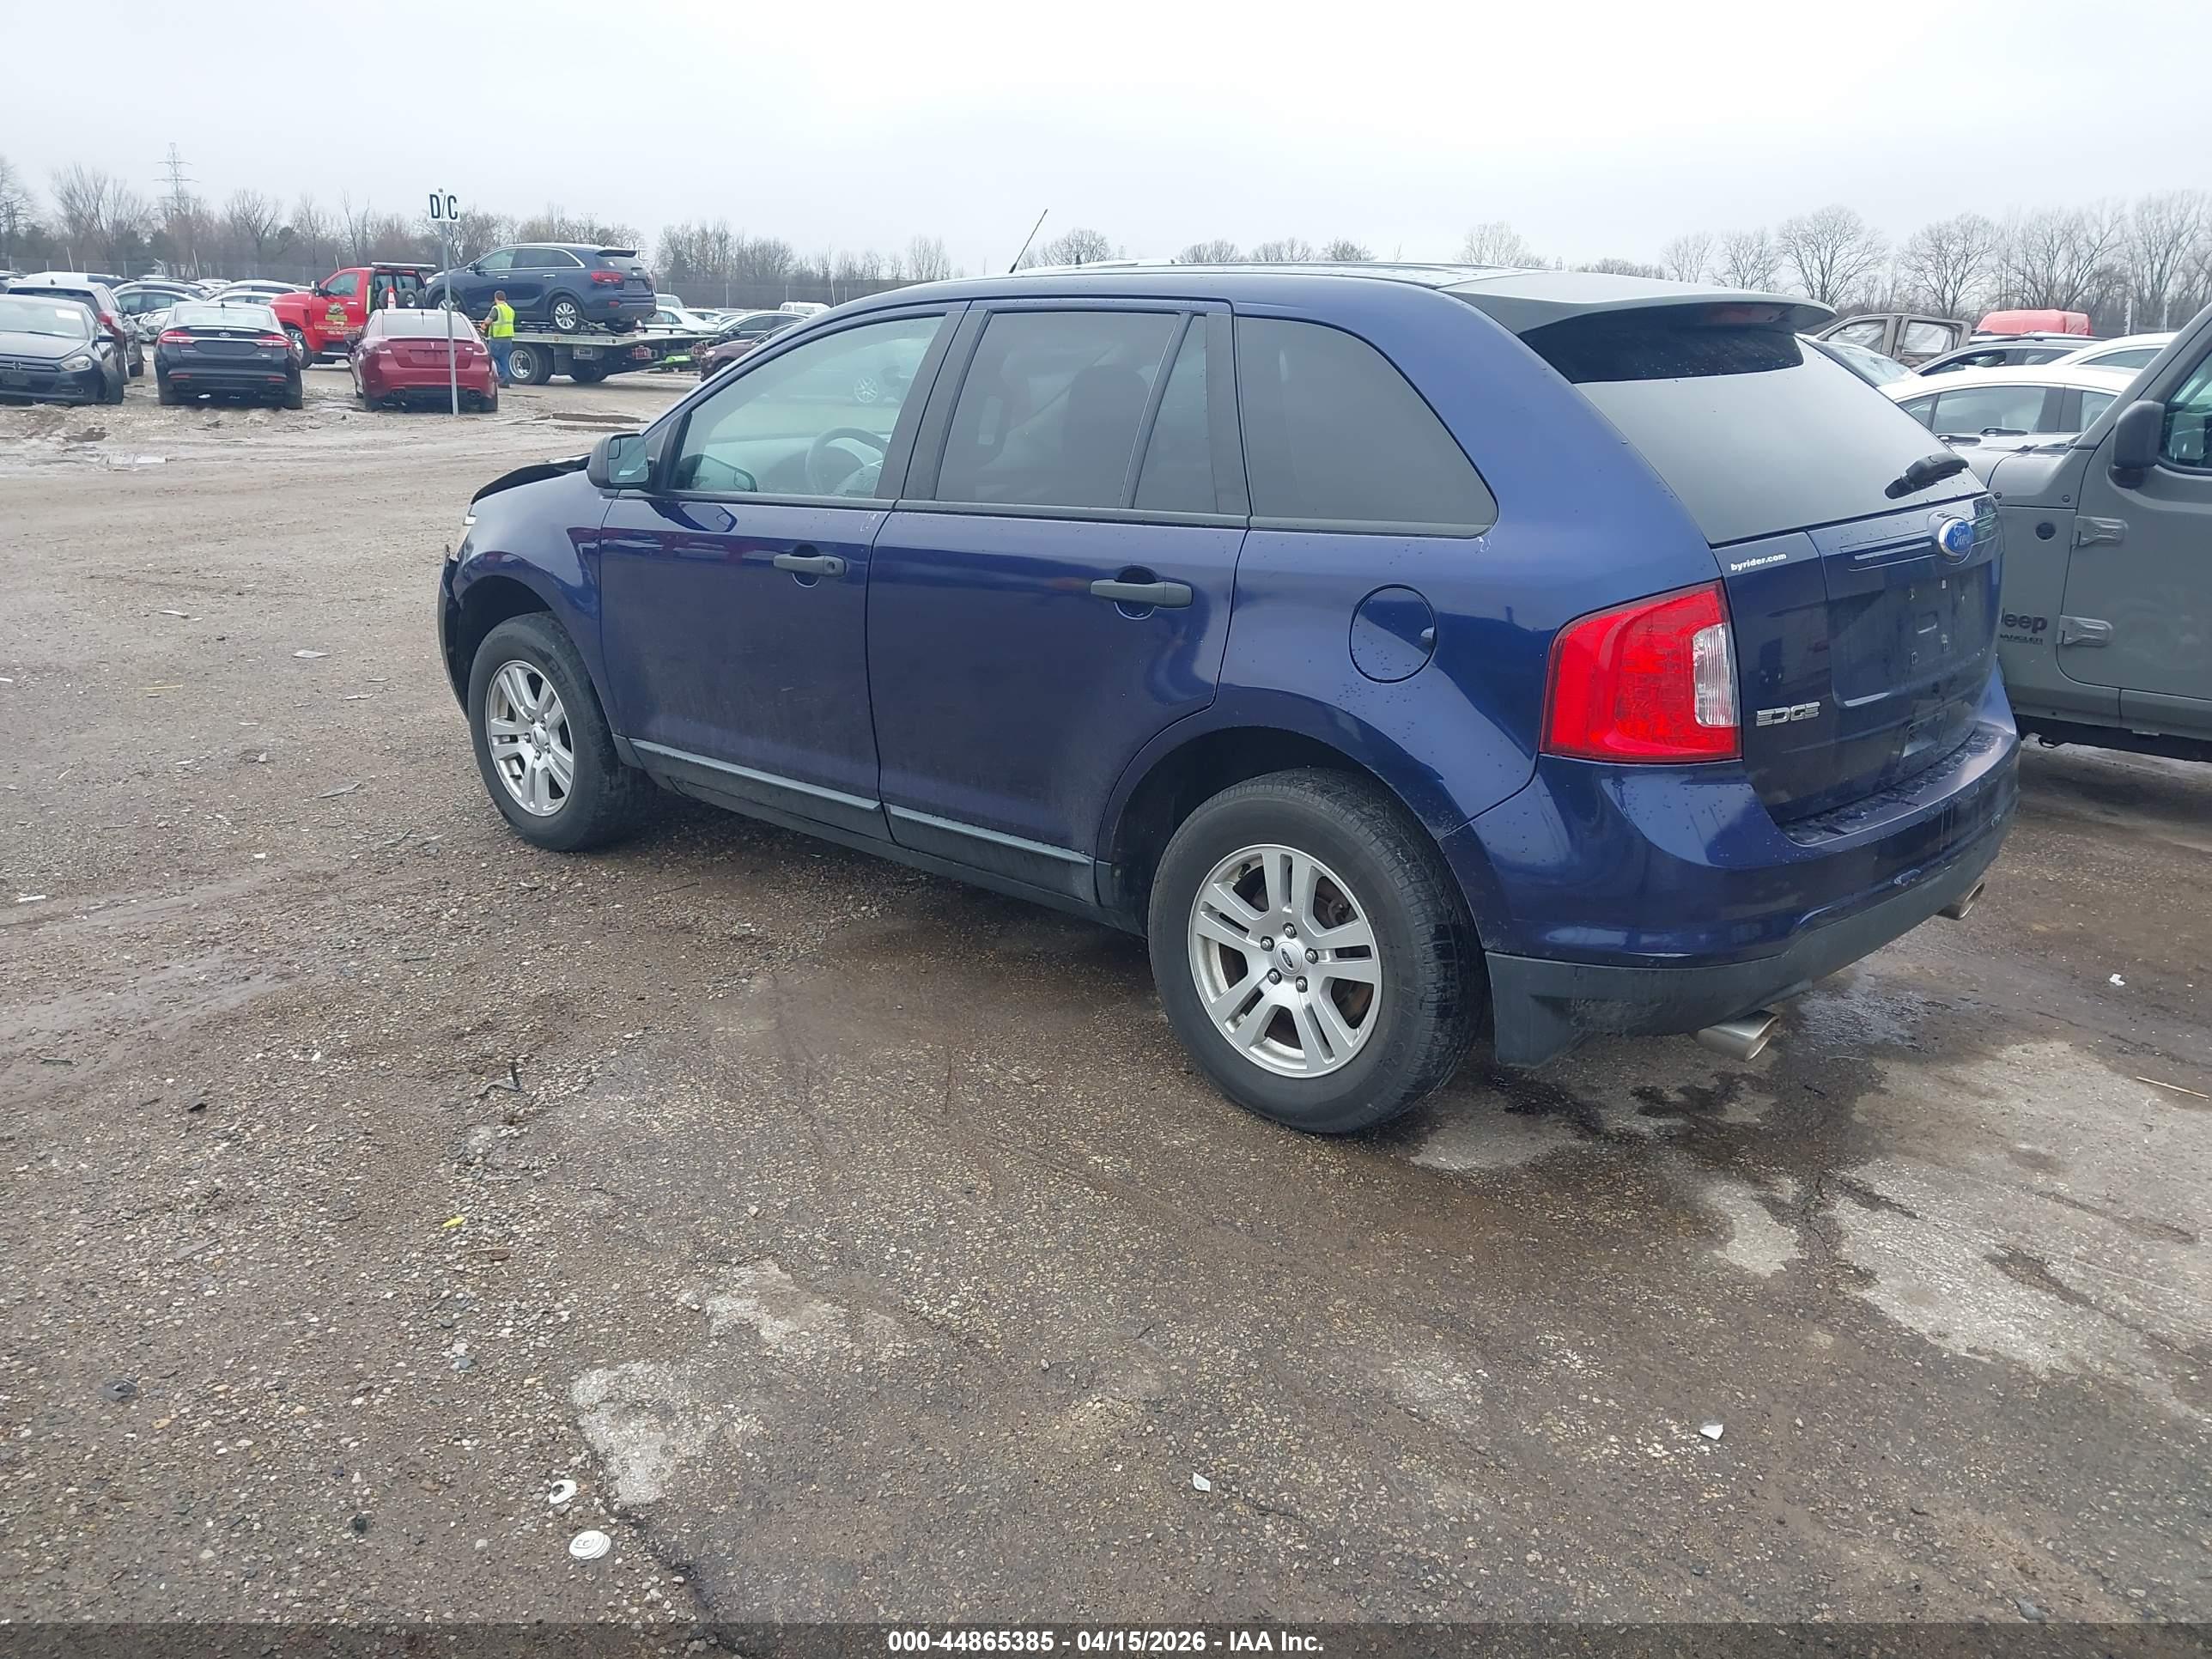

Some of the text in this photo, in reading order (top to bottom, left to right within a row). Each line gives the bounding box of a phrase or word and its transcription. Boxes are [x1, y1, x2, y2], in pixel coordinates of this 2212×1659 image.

[429, 193, 459, 220] D/C
[1730, 552, 1787, 572] byrider.com
[1756, 701, 1820, 726] EDGE
